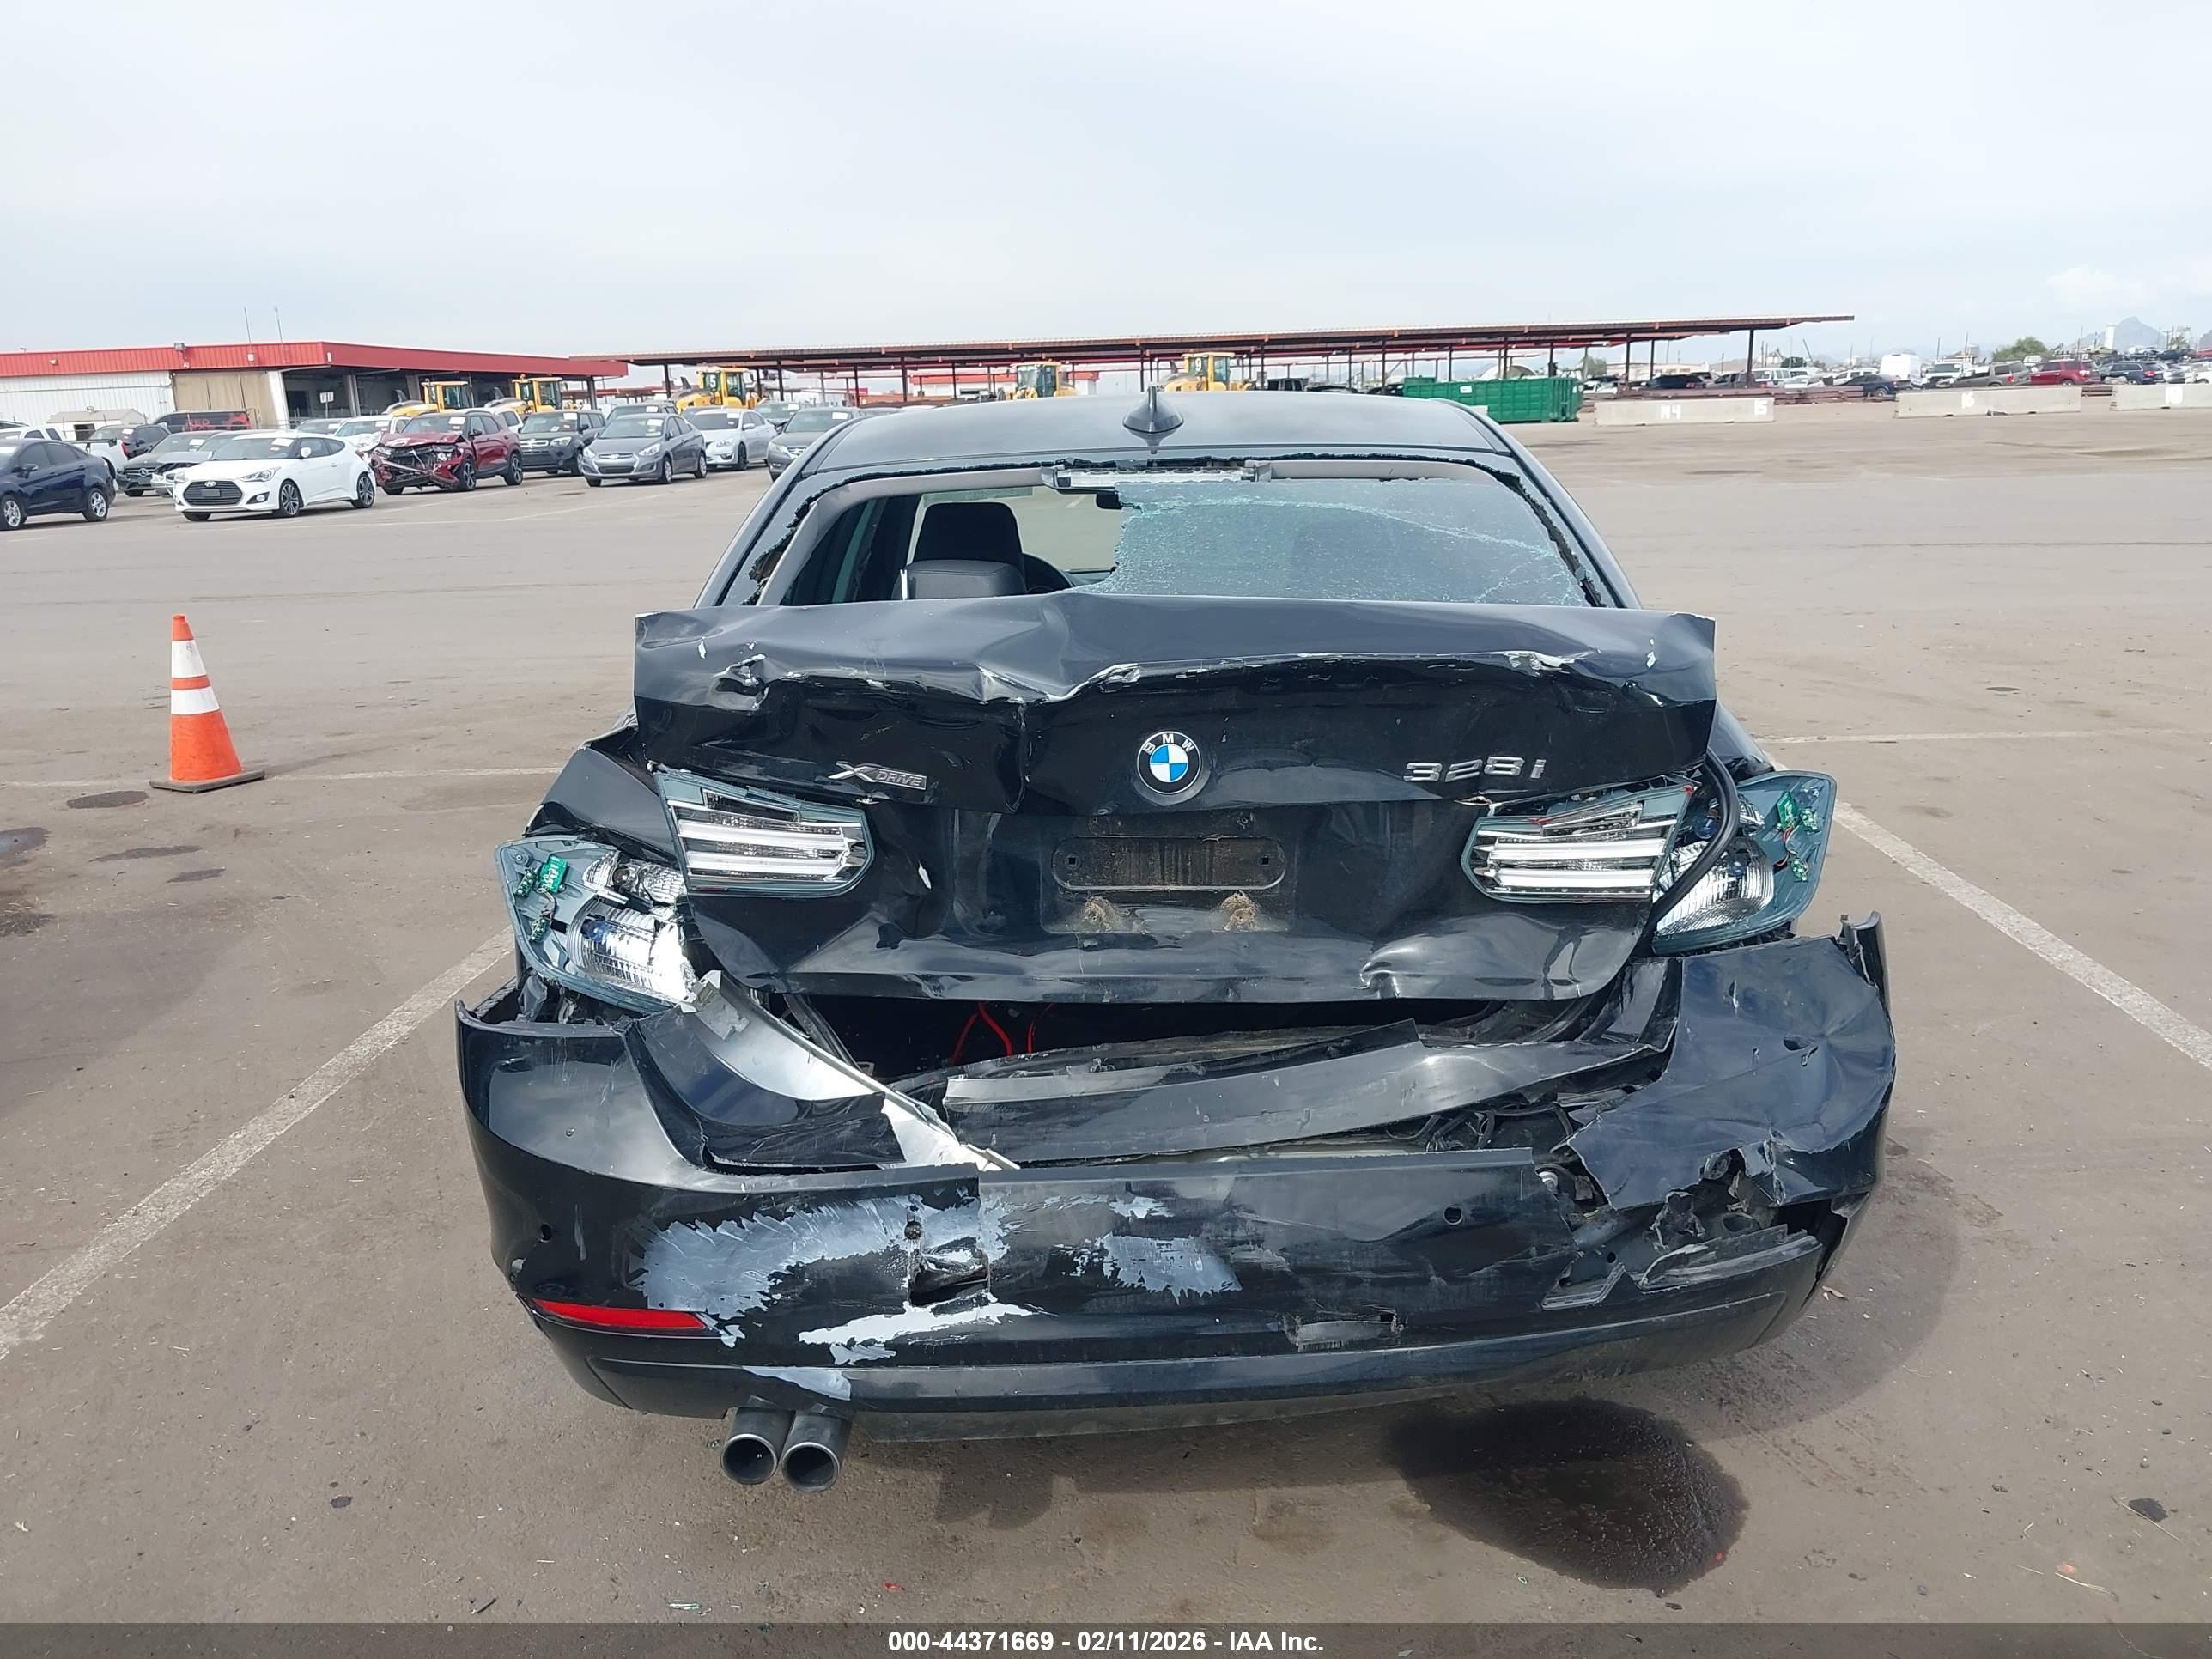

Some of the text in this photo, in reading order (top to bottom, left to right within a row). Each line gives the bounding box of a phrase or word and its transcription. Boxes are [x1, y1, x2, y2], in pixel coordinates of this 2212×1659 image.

[1194, 357, 1202, 372] 9
[709, 374, 717, 388] 5
[1142, 733, 1194, 756] BMW
[1403, 756, 1547, 783] 328i
